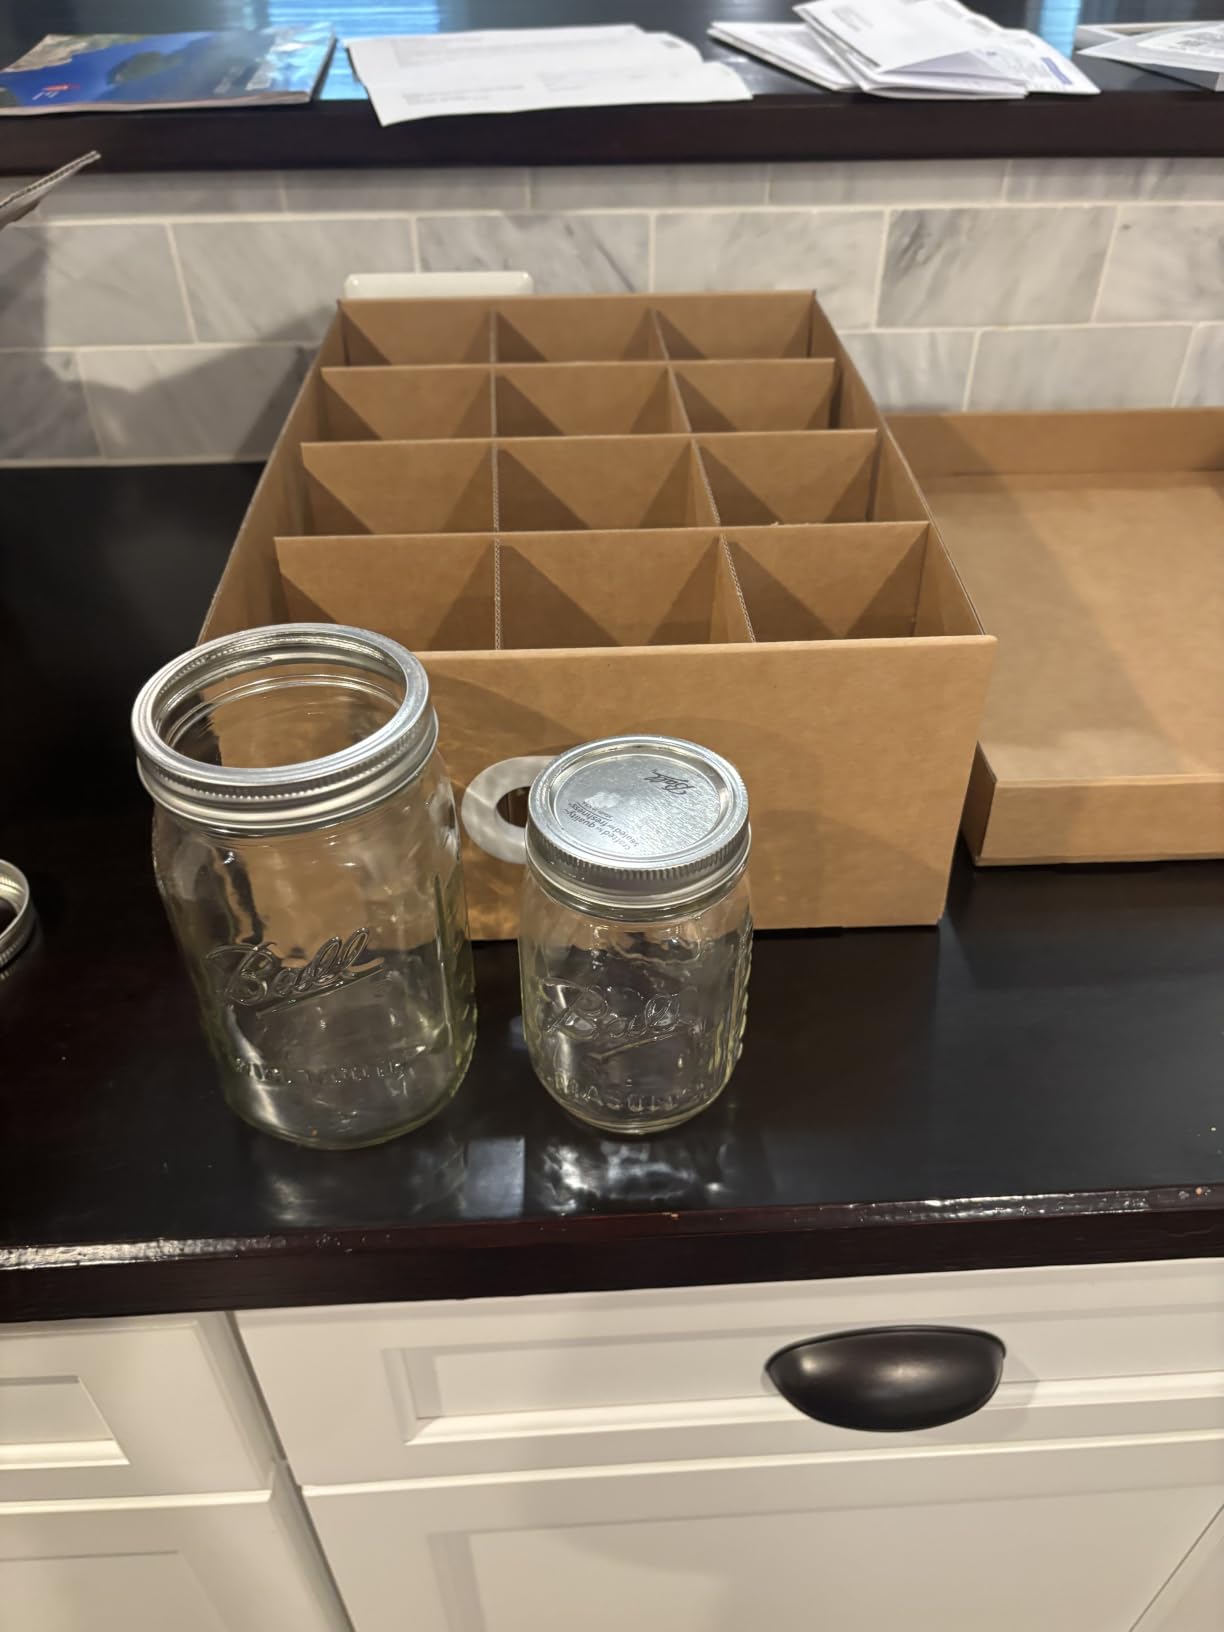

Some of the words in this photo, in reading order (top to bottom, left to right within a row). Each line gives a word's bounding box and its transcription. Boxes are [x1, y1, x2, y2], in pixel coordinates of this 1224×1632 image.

[643, 771, 696, 795] Ball
[567, 810, 596, 828] quality
[571, 803, 608, 827] freshness
[207, 927, 384, 1016] Ball
[538, 977, 682, 1057] Ball
